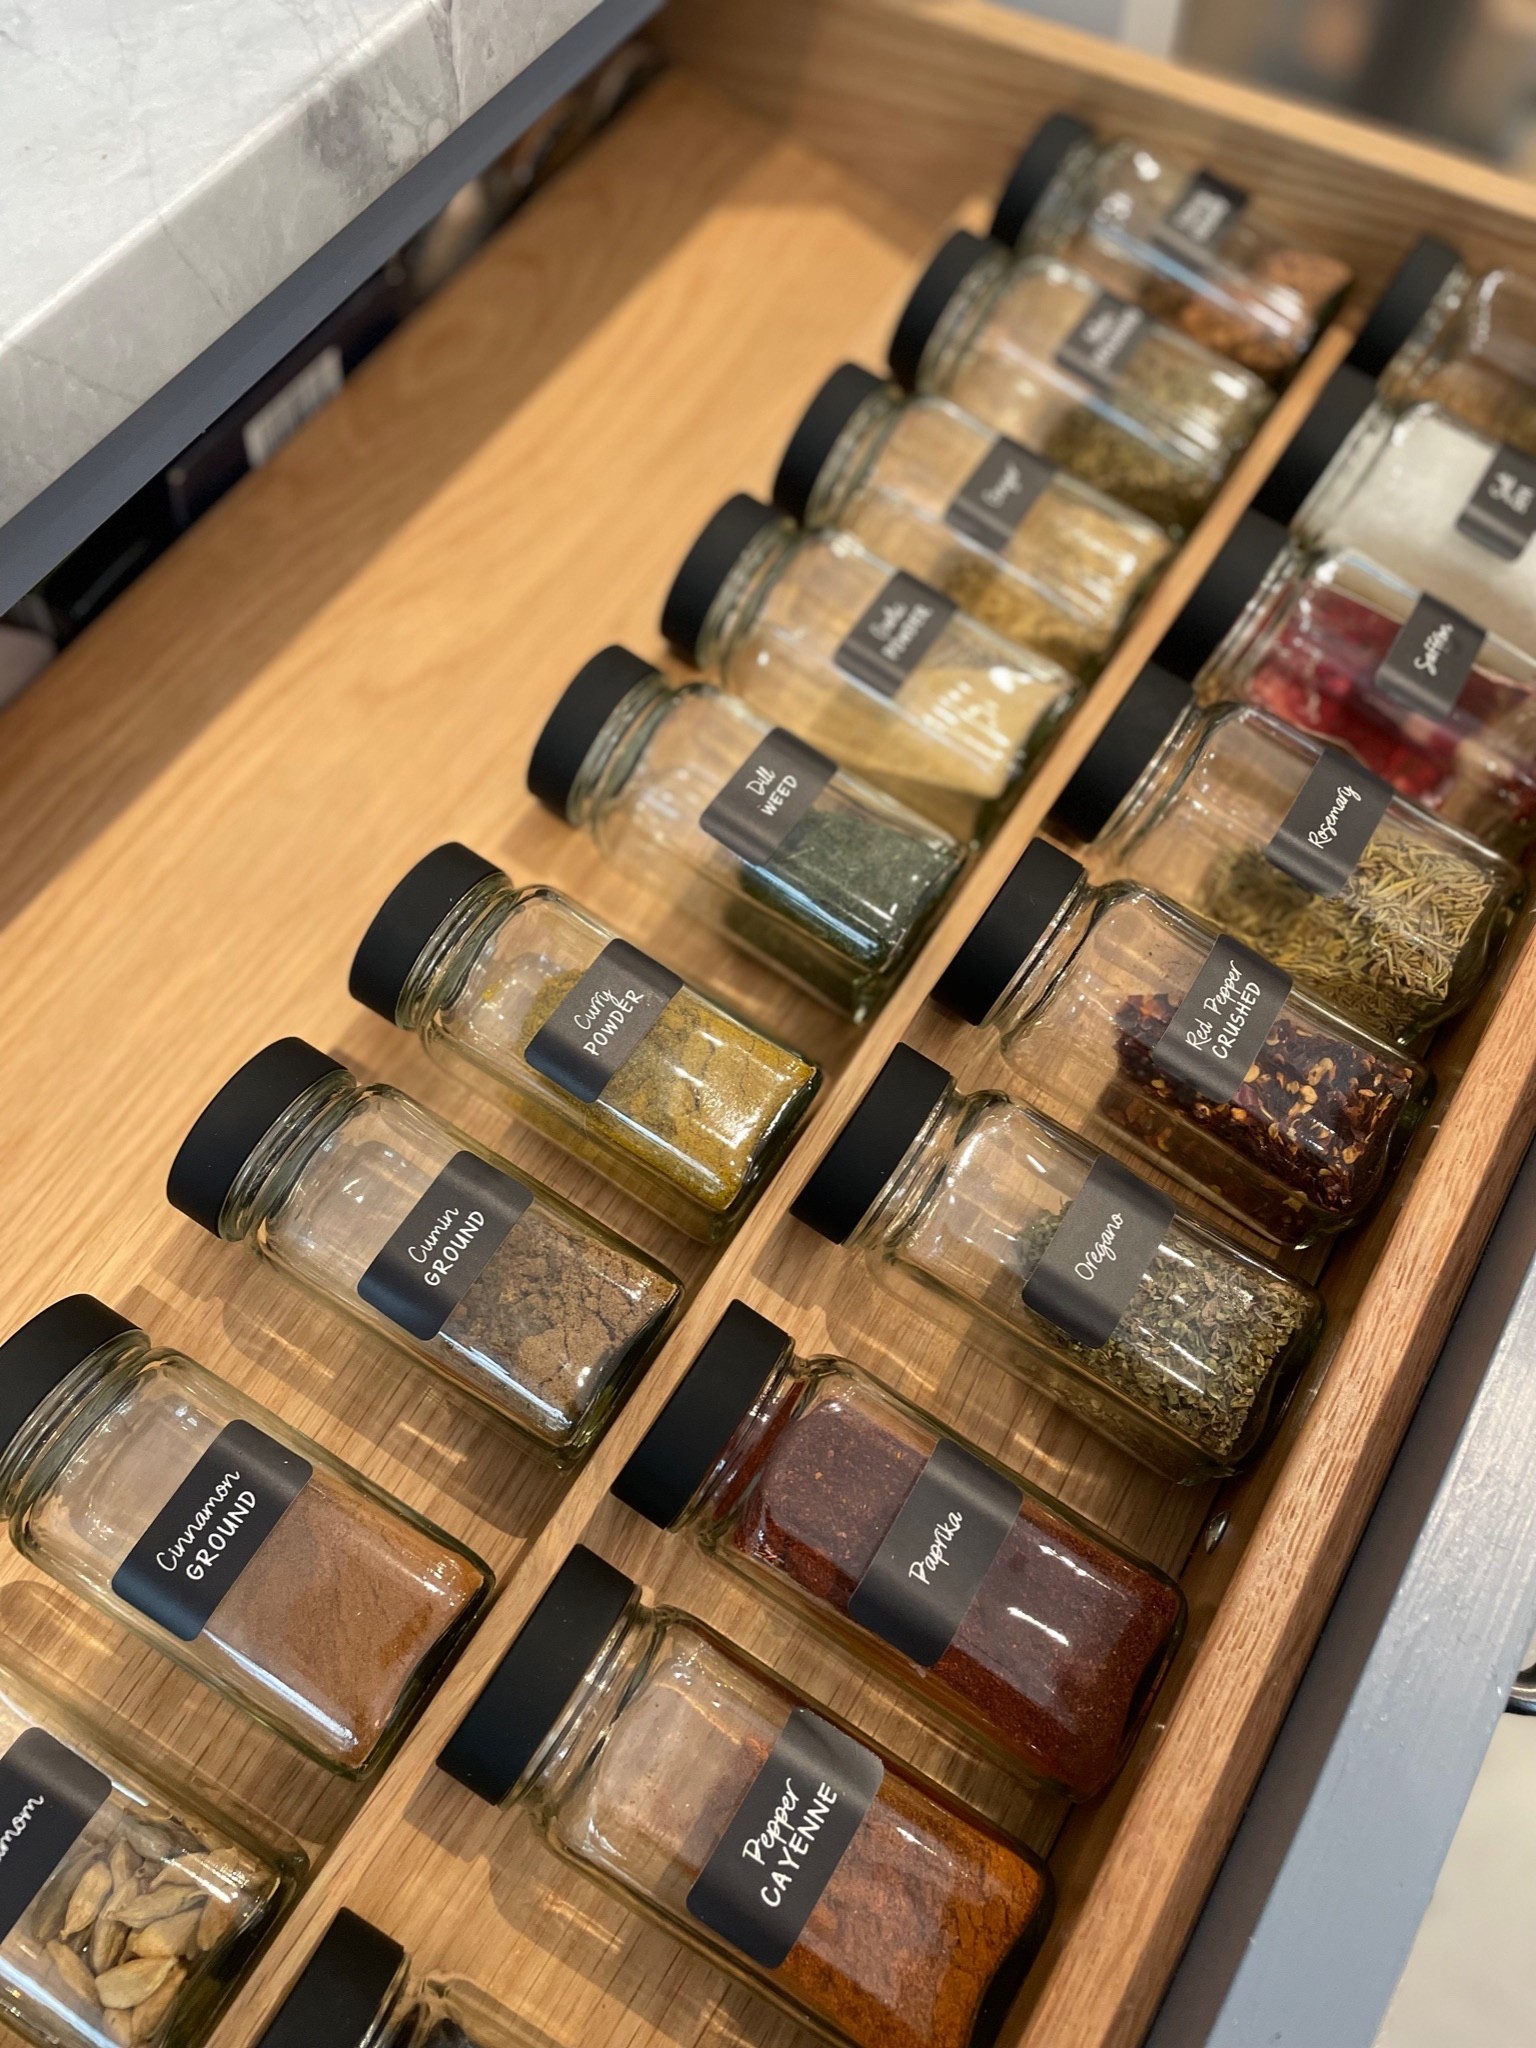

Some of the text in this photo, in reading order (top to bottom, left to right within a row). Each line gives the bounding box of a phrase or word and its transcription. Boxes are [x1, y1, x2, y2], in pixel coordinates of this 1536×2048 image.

[745, 765, 776, 797] Dill
[760, 774, 798, 817] WEED
[1307, 784, 1361, 849] Rosemary
[573, 987, 621, 1030] Curry
[583, 989, 645, 1057] POWDER
[1185, 960, 1243, 1051] Red Pepper
[1211, 981, 1261, 1060] CRUSHED
[407, 1206, 459, 1264] Cumin
[423, 1210, 485, 1287] GROUND
[1074, 1212, 1124, 1281] Oregano
[156, 1470, 241, 1573] Cinnamon
[185, 1489, 257, 1581] GROUND
[908, 1511, 963, 1585] Paprika
[741, 1777, 800, 1865] Pepper
[760, 1782, 838, 1908] CAYENNE
